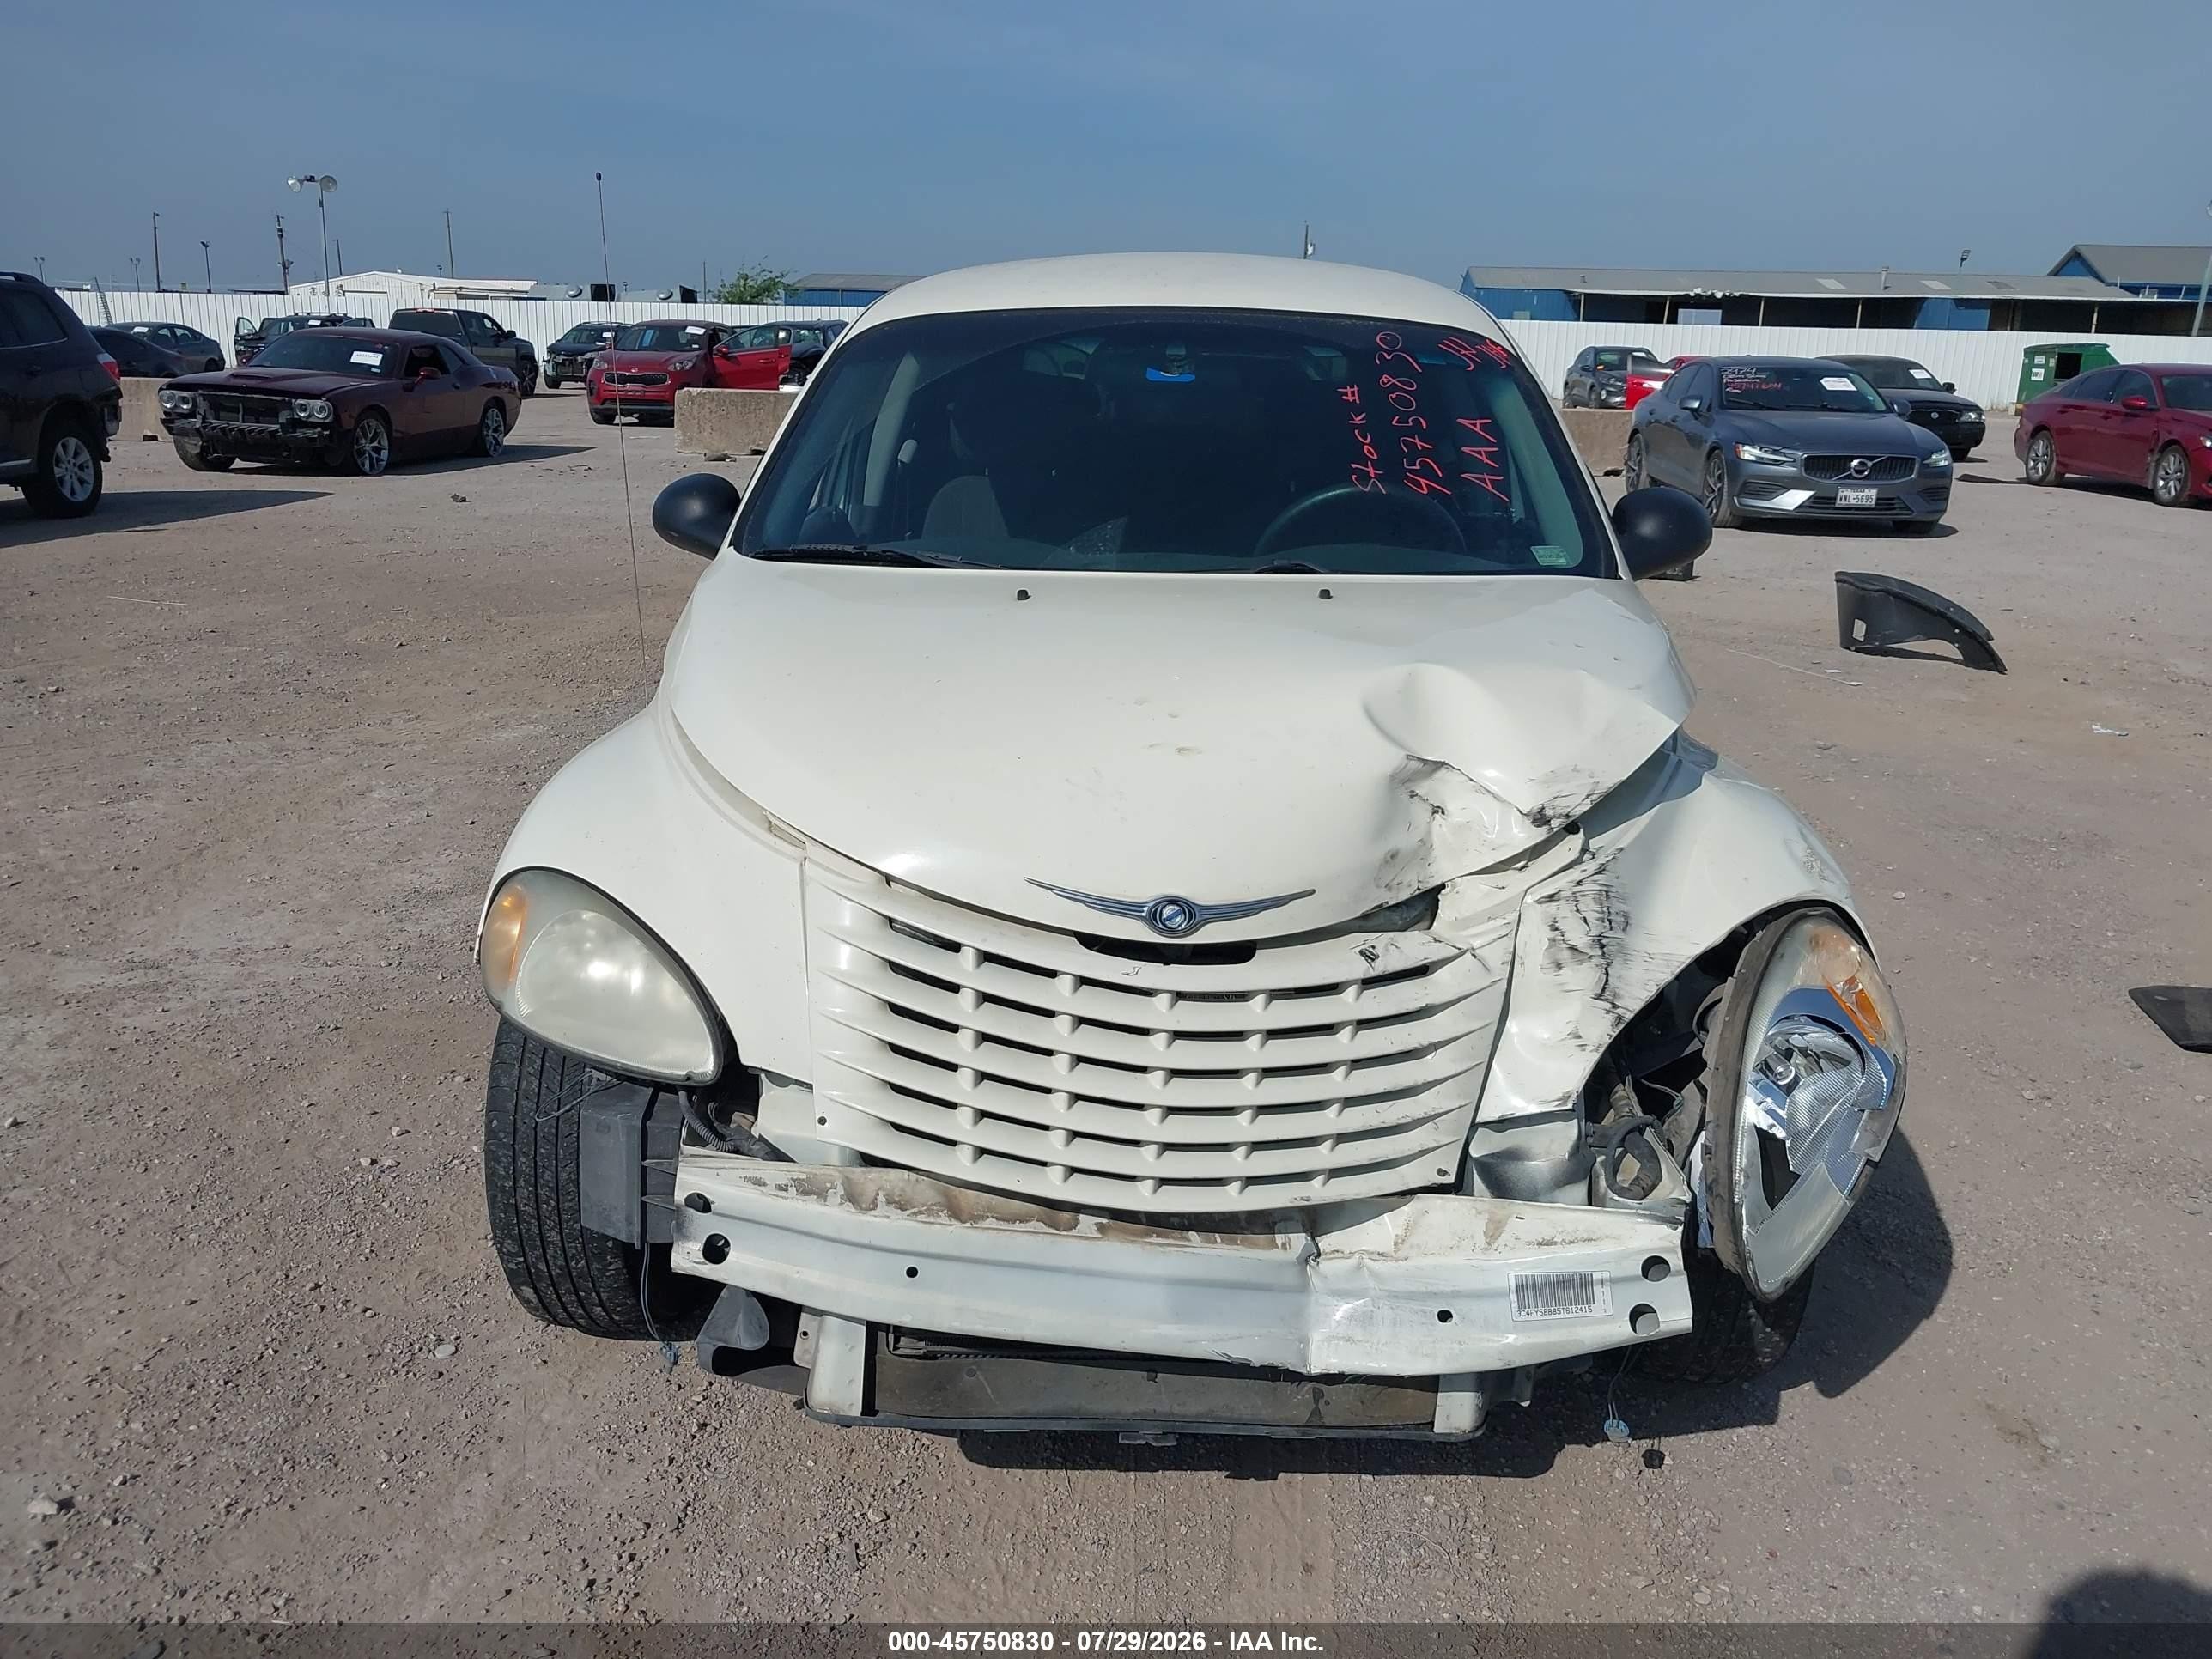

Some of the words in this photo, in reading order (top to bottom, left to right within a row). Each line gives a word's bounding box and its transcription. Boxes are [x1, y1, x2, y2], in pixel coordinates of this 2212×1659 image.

[1336, 384, 1361, 404] #
[1376, 331, 1452, 495] 45750830
[1455, 417, 1510, 502] AAA
